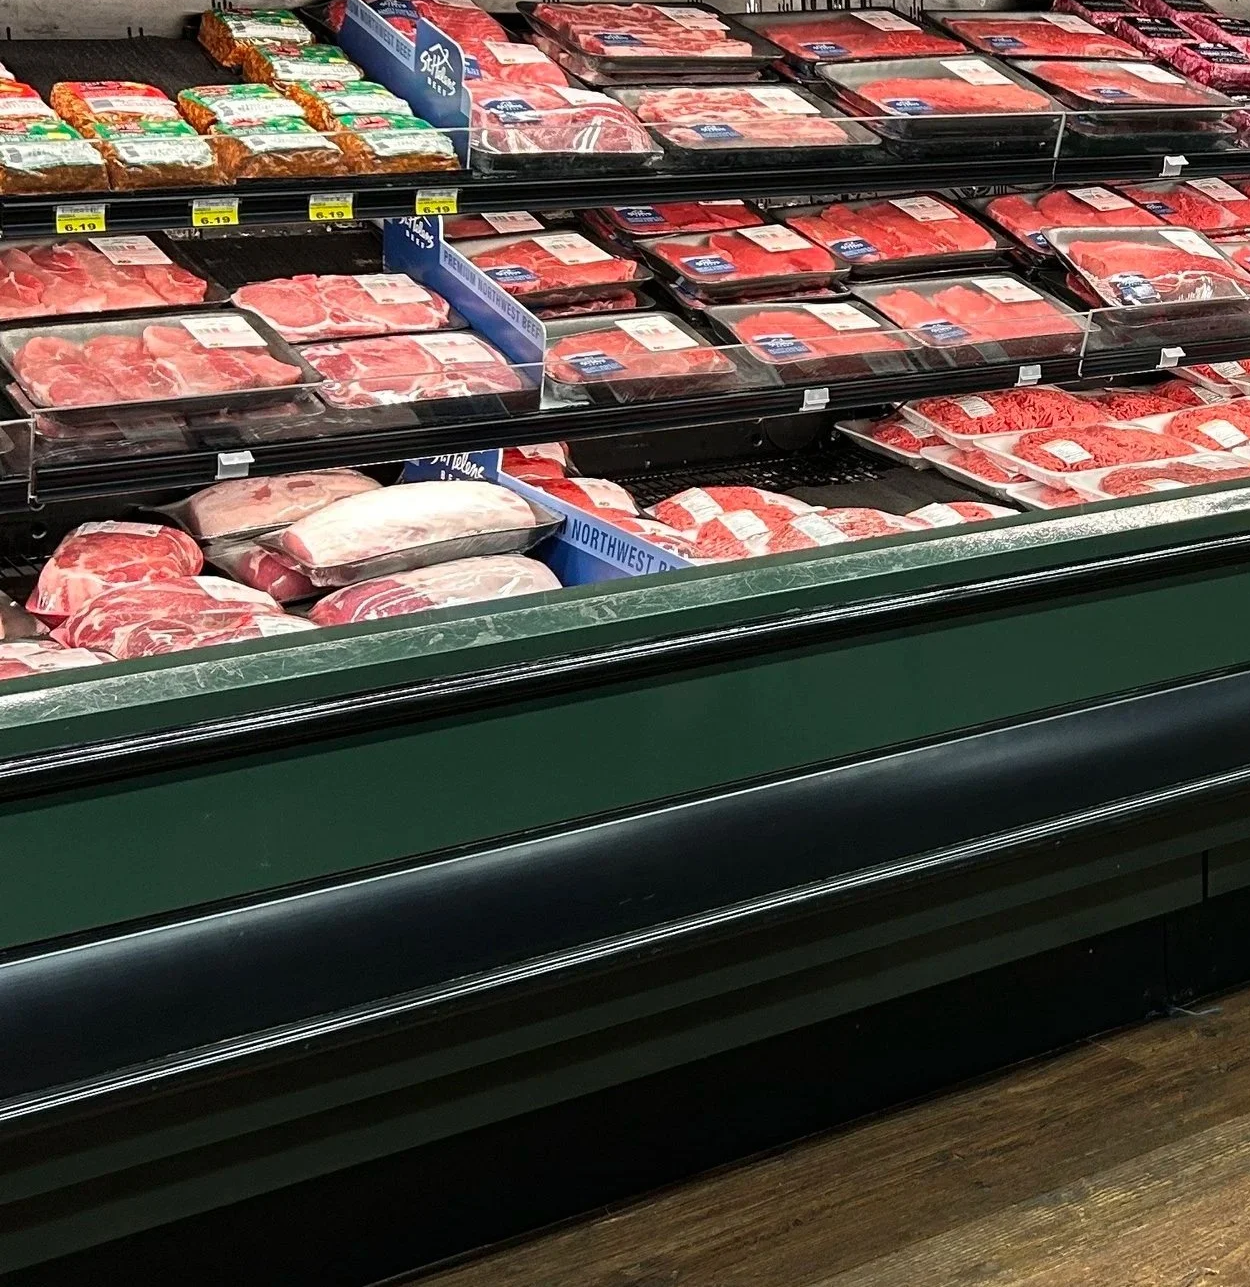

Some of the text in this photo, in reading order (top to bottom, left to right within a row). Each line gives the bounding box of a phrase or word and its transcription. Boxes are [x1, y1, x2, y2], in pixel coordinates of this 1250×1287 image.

[422, 205, 451, 214] 6.19
[315, 211, 344, 220] 6.19
[200, 216, 231, 225] 6.19
[64, 222, 97, 232] 6.19
[443, 249, 542, 340] PREMIUM NORTHWEST BEEF
[571, 516, 655, 574] NORTHWEST
